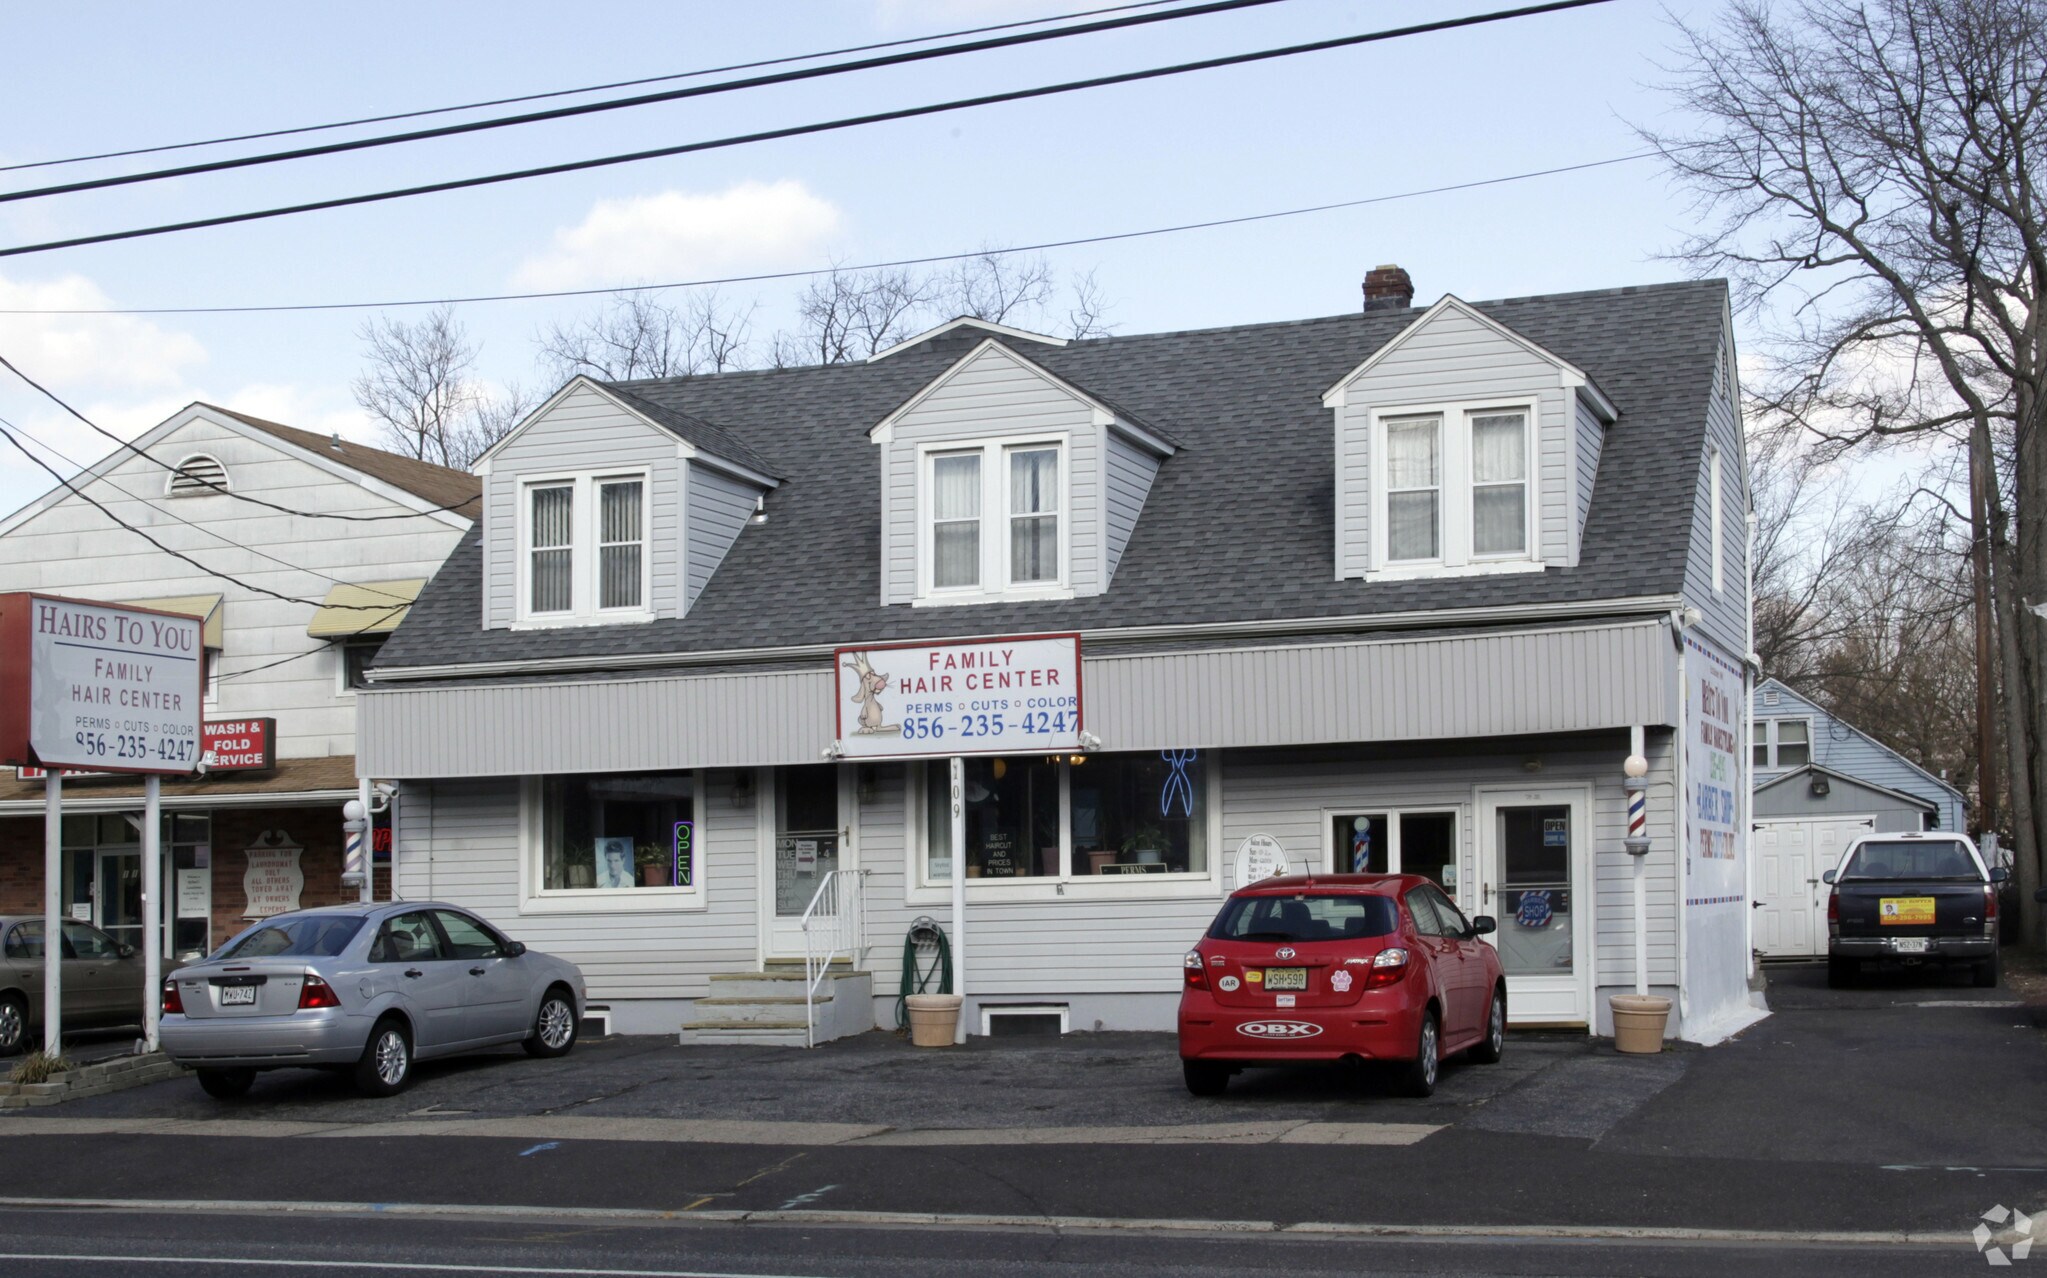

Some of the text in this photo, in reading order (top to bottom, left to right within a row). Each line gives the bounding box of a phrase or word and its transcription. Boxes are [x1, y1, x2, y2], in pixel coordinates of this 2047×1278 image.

[38, 605, 193, 651] HAIRS TO YOU
[929, 650, 1014, 671] FAMILY
[94, 658, 153, 683] FAMILY
[900, 669, 1060, 694] HAIR CENTER
[72, 684, 182, 712] HAIR CENTER
[906, 696, 1077, 714] PERMS CUTS COLOR
[75, 716, 194, 736] PERMS CUTS COLOR
[204, 722, 261, 736] WASH &
[903, 710, 1079, 740] 856-235-4247
[214, 739, 251, 751] FOLD
[212, 753, 263, 766] ERVICE
[1545, 821, 1566, 831] OPEN
[990, 833, 1007, 841] BEST
[676, 824, 691, 884] OPEN
[993, 850, 1006, 858] AND
[1121, 865, 1147, 874] PERMS
[1524, 906, 1545, 917] SHOP
[1244, 1024, 1311, 1034] OBX
